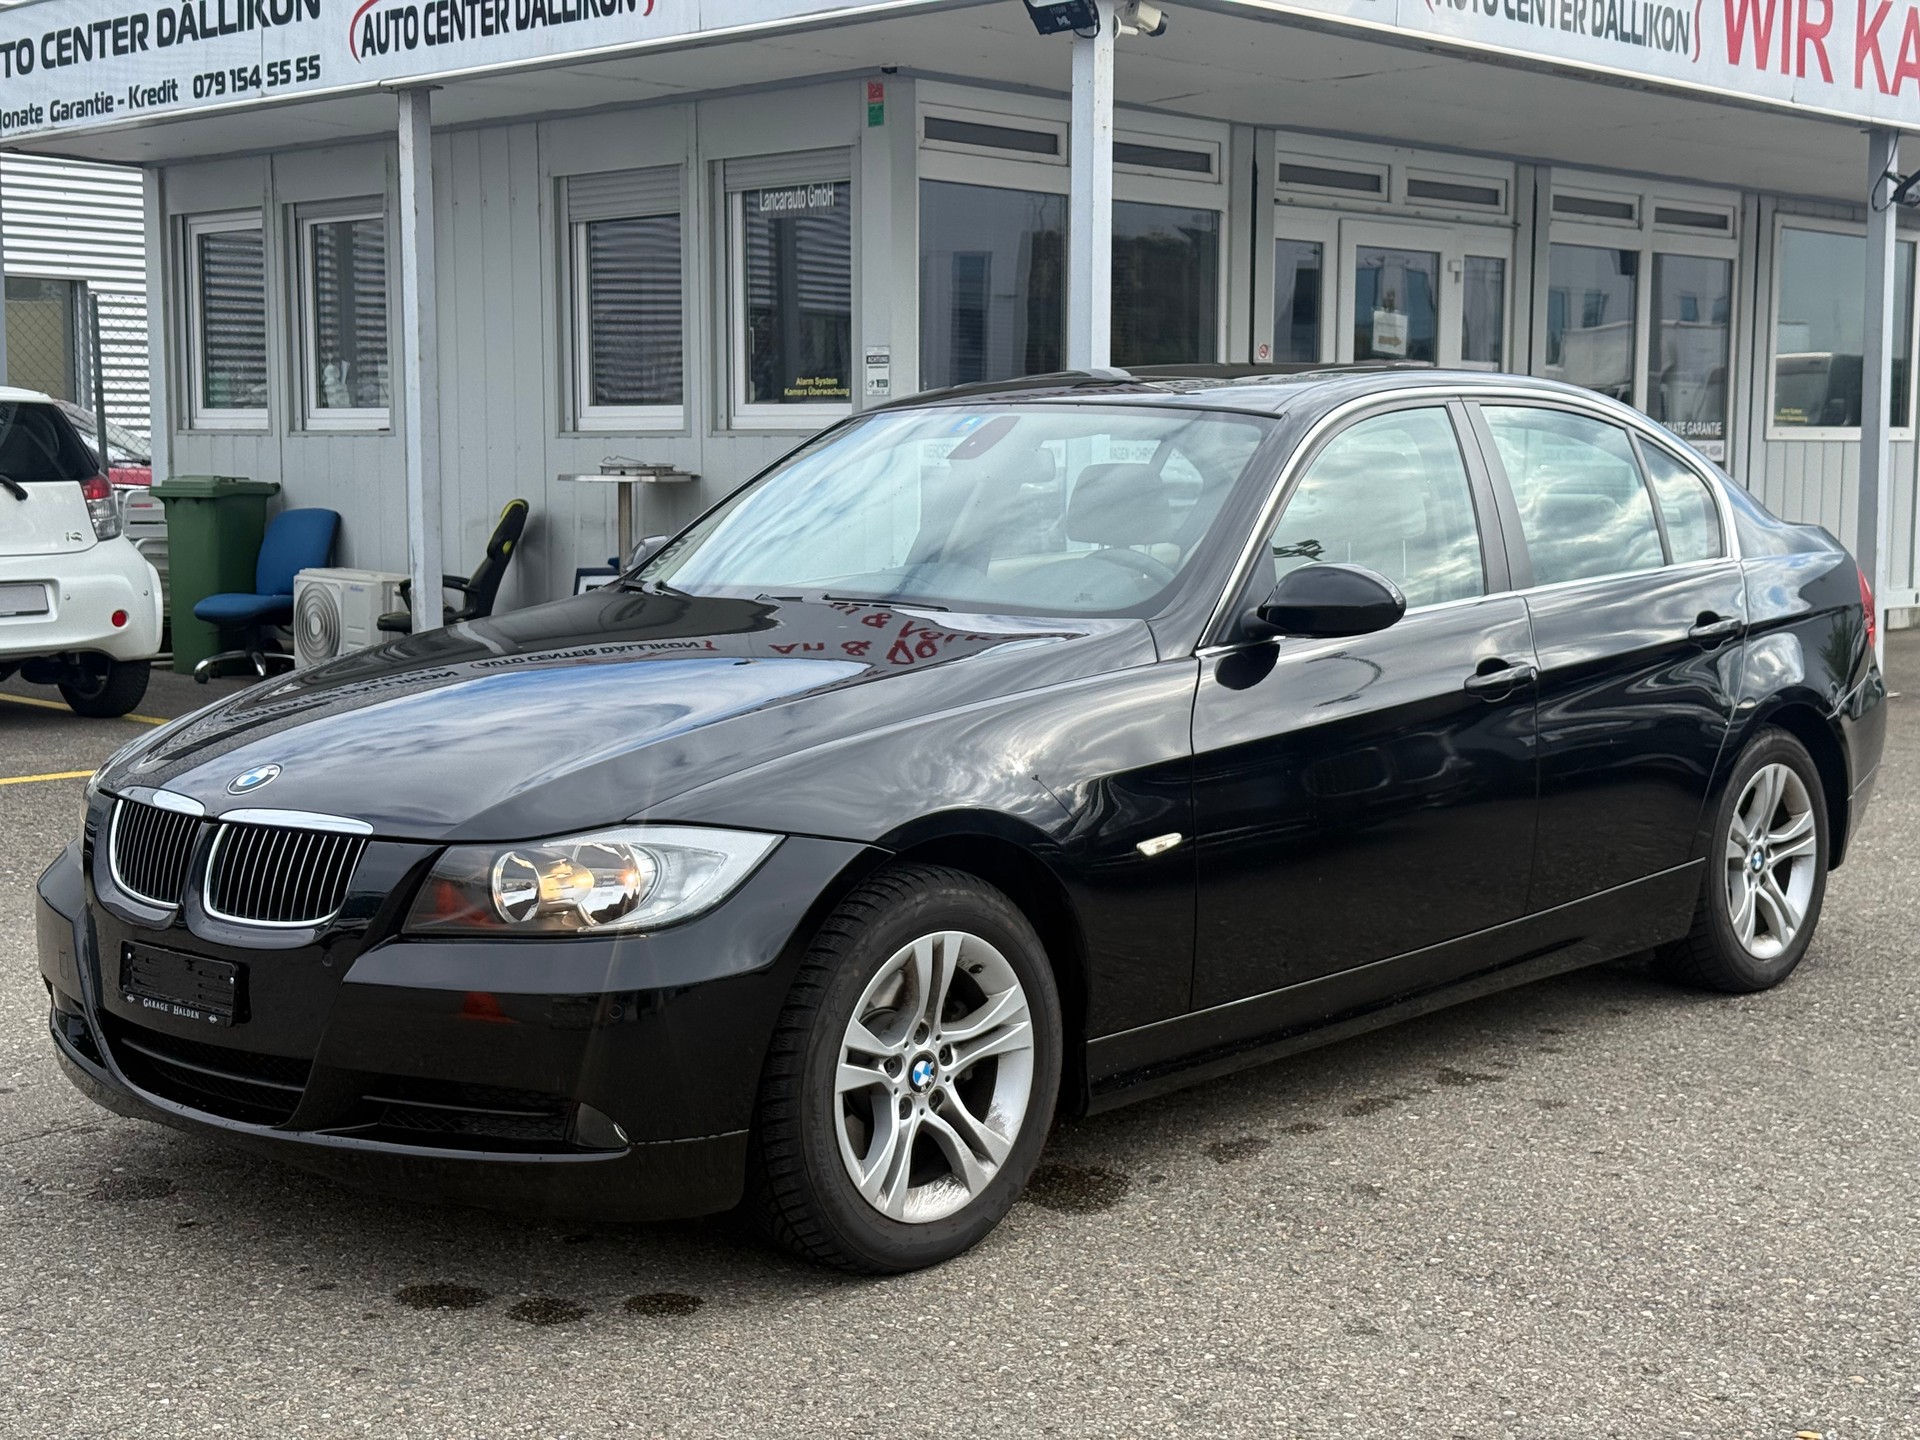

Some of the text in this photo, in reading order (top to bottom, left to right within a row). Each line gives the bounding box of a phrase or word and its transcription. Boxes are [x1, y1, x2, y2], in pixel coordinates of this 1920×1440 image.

[41, 12, 150, 70] CENTER
[361, 5, 419, 58] AUTO
[424, 0, 510, 46] CENTER
[1724, 0, 1834, 84] WIR
[0, 103, 43, 130] onate
[50, 91, 114, 122] Garantie
[128, 78, 178, 110] Kredit
[193, 71, 226, 99] 079
[229, 64, 262, 93] 154
[267, 59, 291, 87] 55
[296, 54, 320, 83] 55
[760, 182, 834, 212] Lancarauto GmbH
[795, 376, 838, 387] Alarm System
[1661, 421, 1722, 436] NATE GARANTIE
[143, 998, 200, 1019] GARAGE HALDEN
